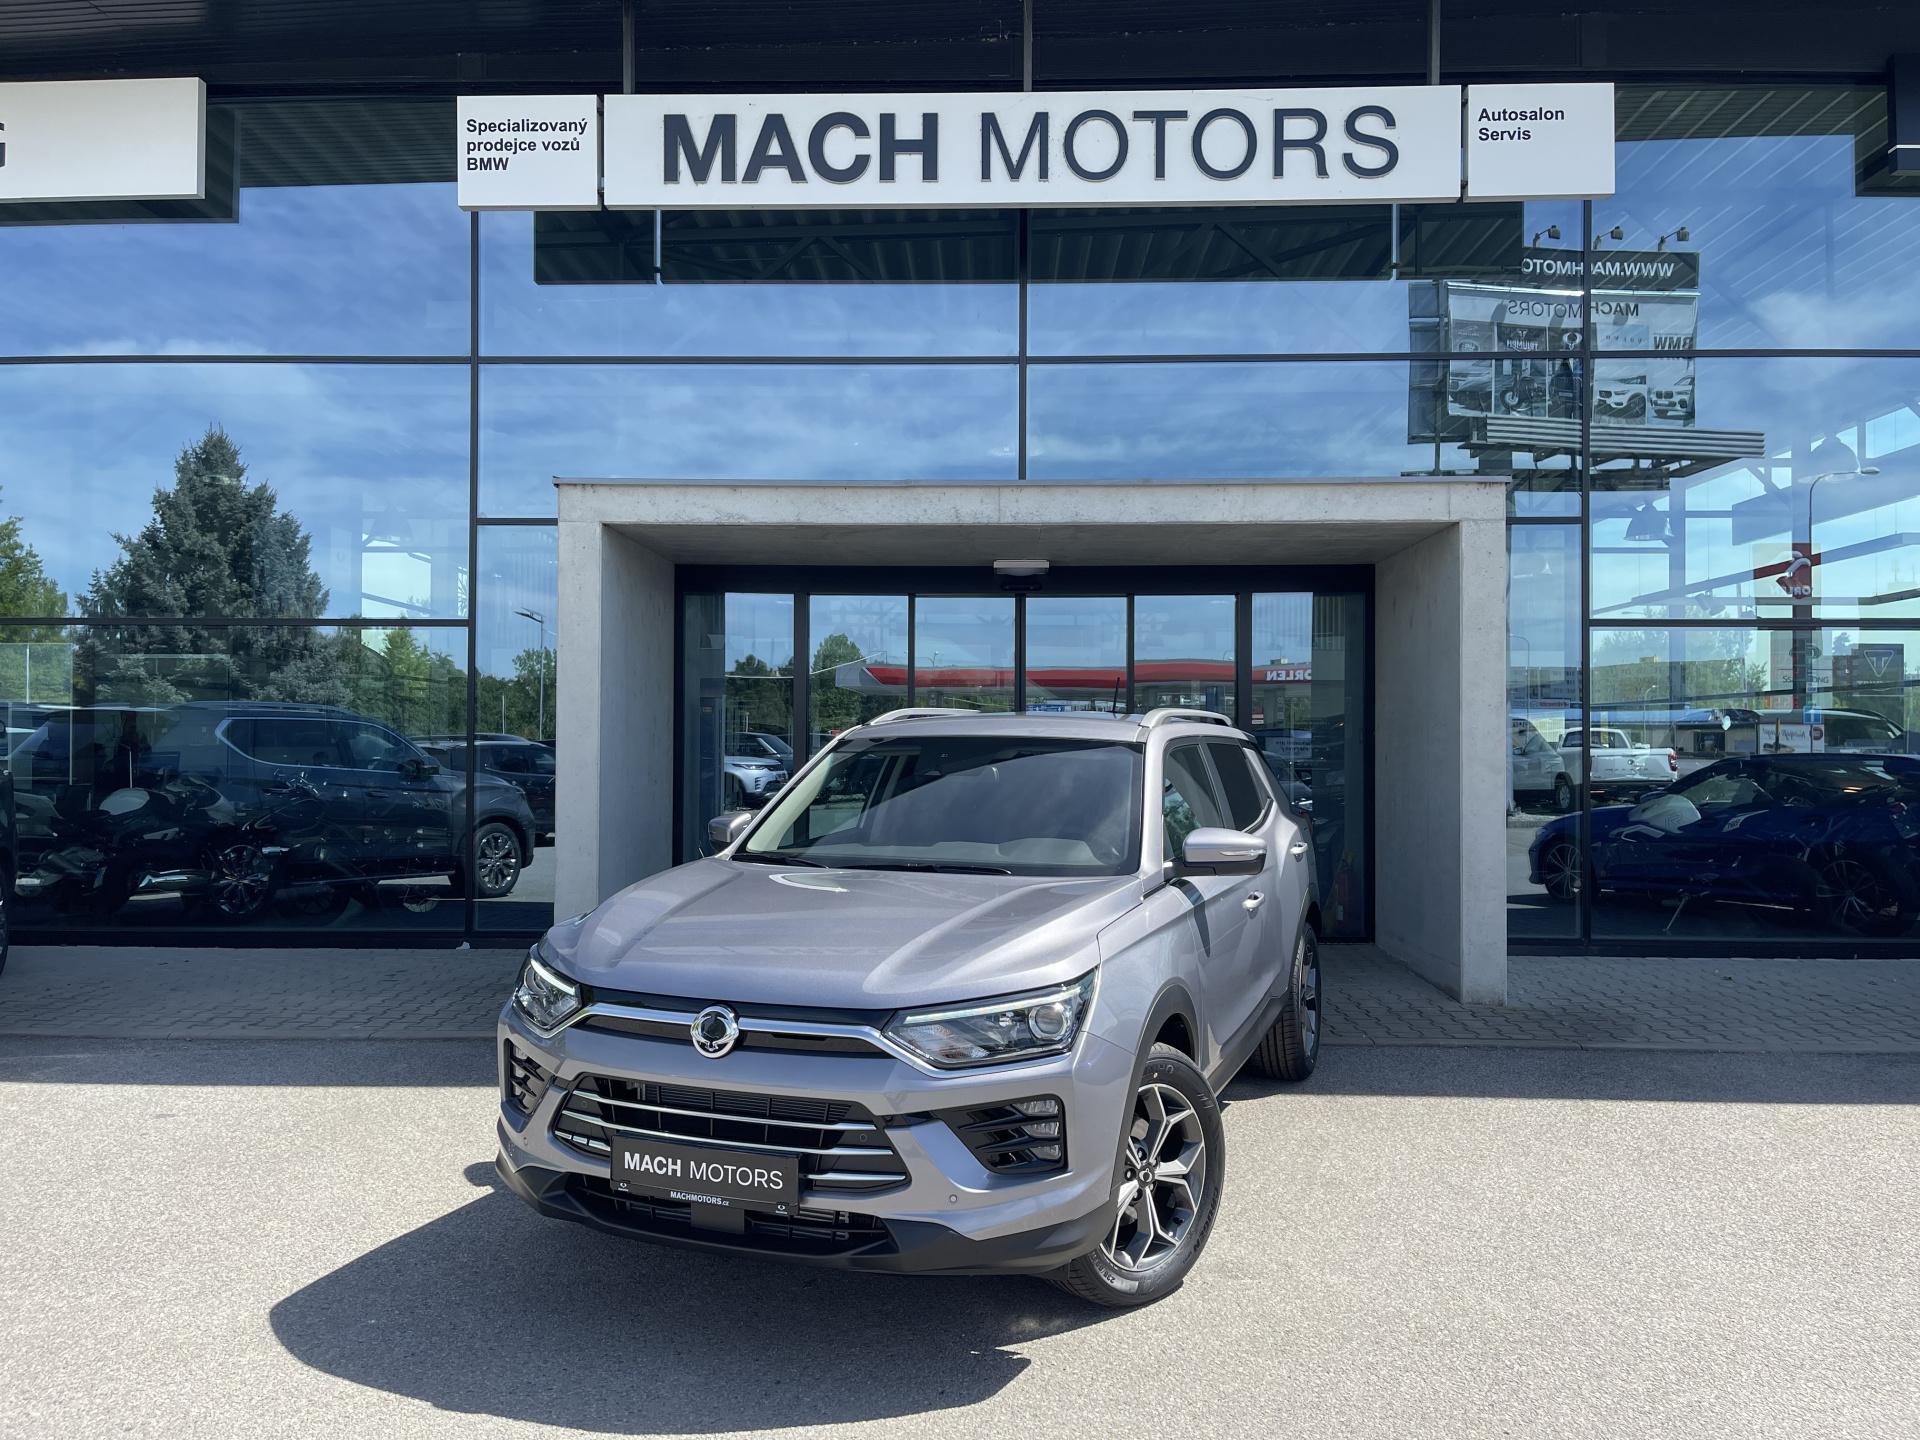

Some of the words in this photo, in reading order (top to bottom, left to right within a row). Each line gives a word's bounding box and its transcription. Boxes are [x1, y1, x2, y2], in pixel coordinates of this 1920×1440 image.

[1477, 106, 1565, 122] Autosalon
[466, 117, 588, 136] Specializovaný
[1477, 126, 1532, 142] Servis
[466, 137, 537, 155] prodejce
[541, 136, 580, 151] vozů
[662, 110, 940, 185] MACH
[980, 105, 1400, 183] MOTORS
[466, 157, 510, 171] BMW
[623, 1151, 682, 1178] MACH
[689, 1160, 784, 1191] MOTORS
